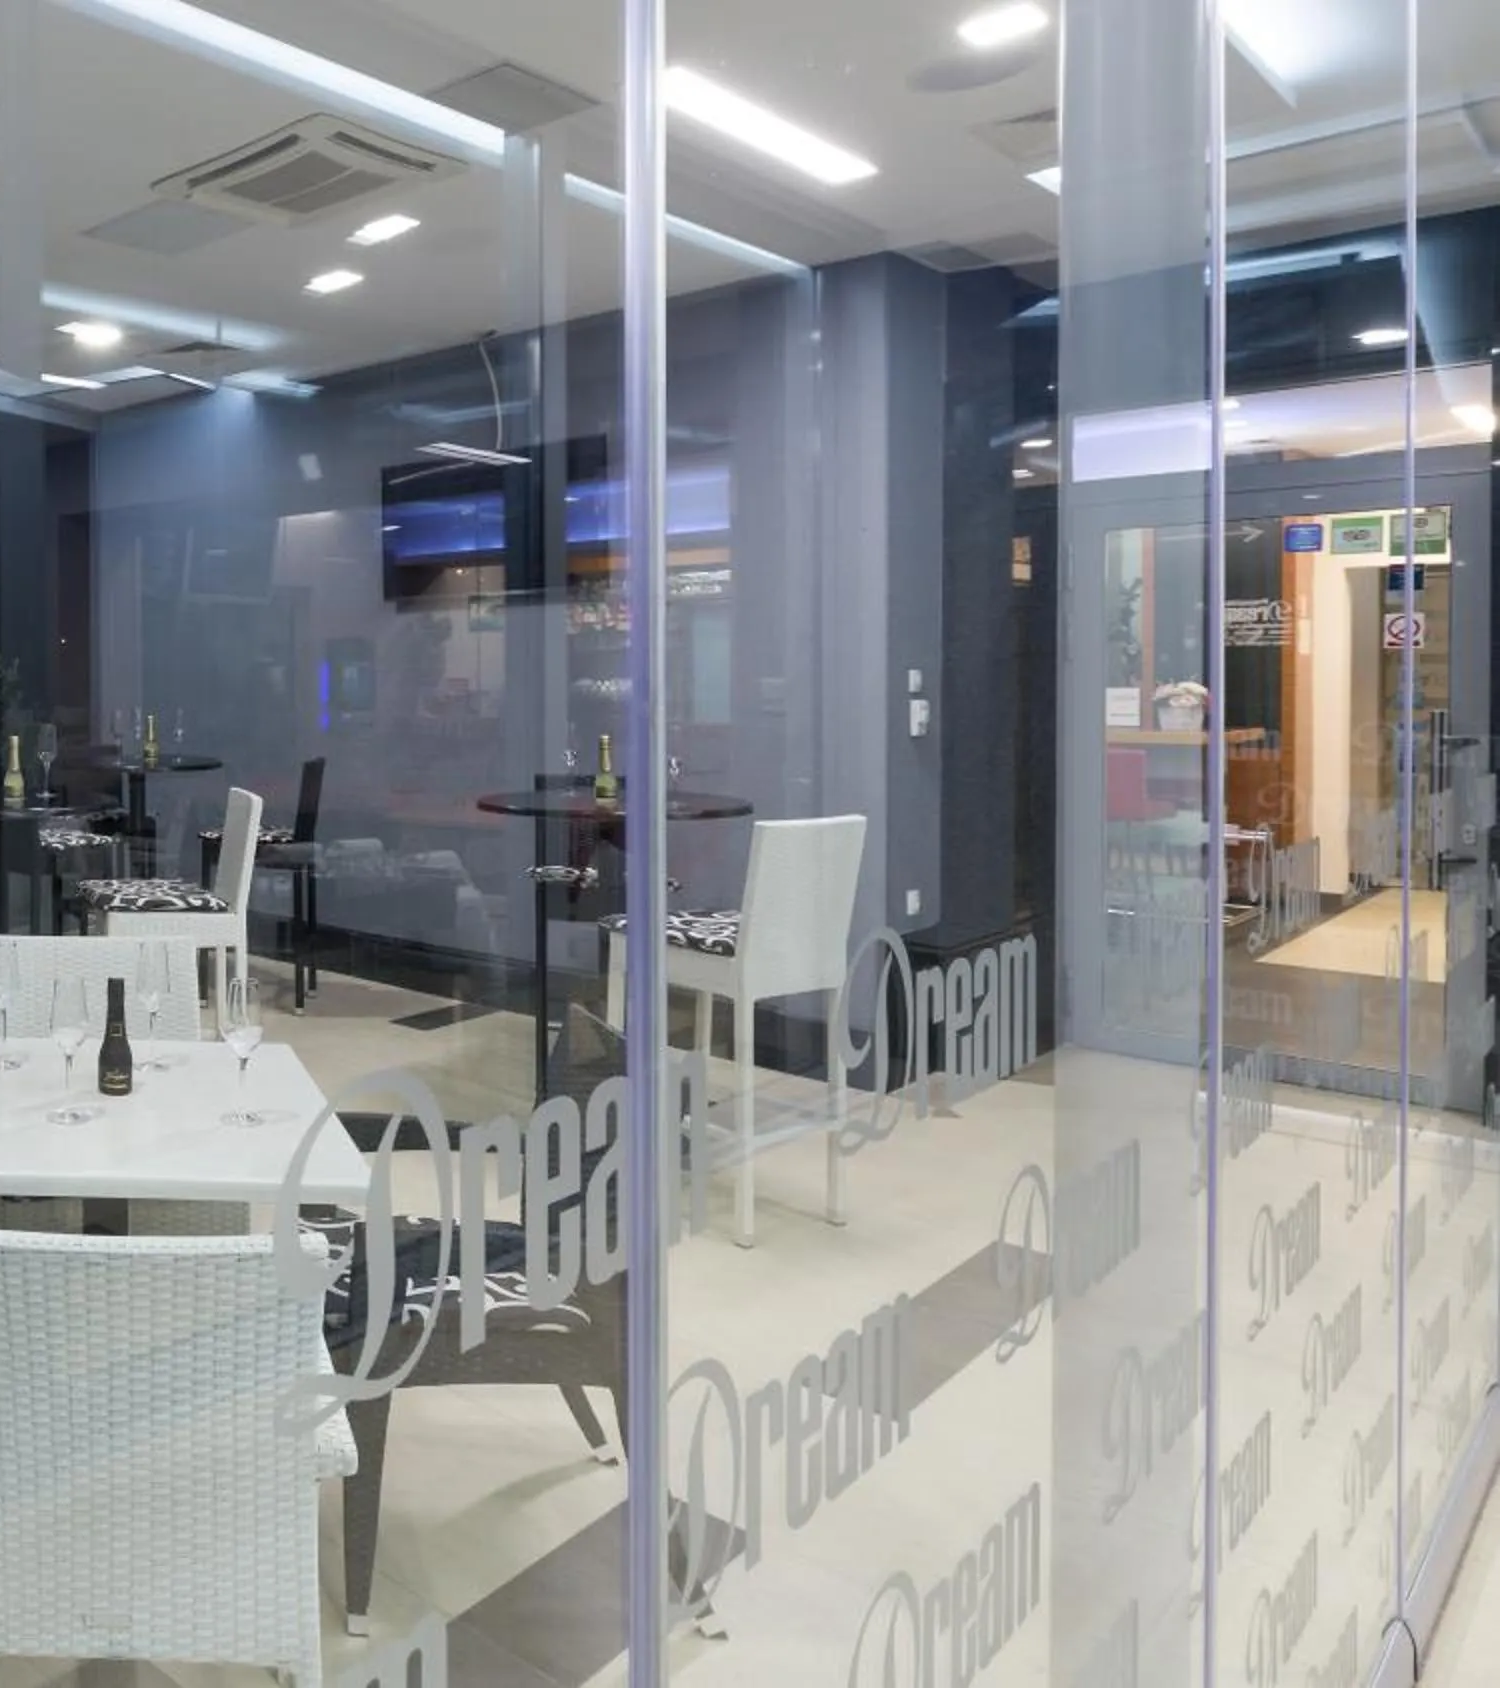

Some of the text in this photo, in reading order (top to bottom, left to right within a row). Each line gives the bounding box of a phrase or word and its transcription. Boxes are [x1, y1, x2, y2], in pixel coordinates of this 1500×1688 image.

[837, 925, 1038, 1157] Dream
[272, 1050, 707, 1437] Dream
[666, 1292, 911, 1635] Dream
